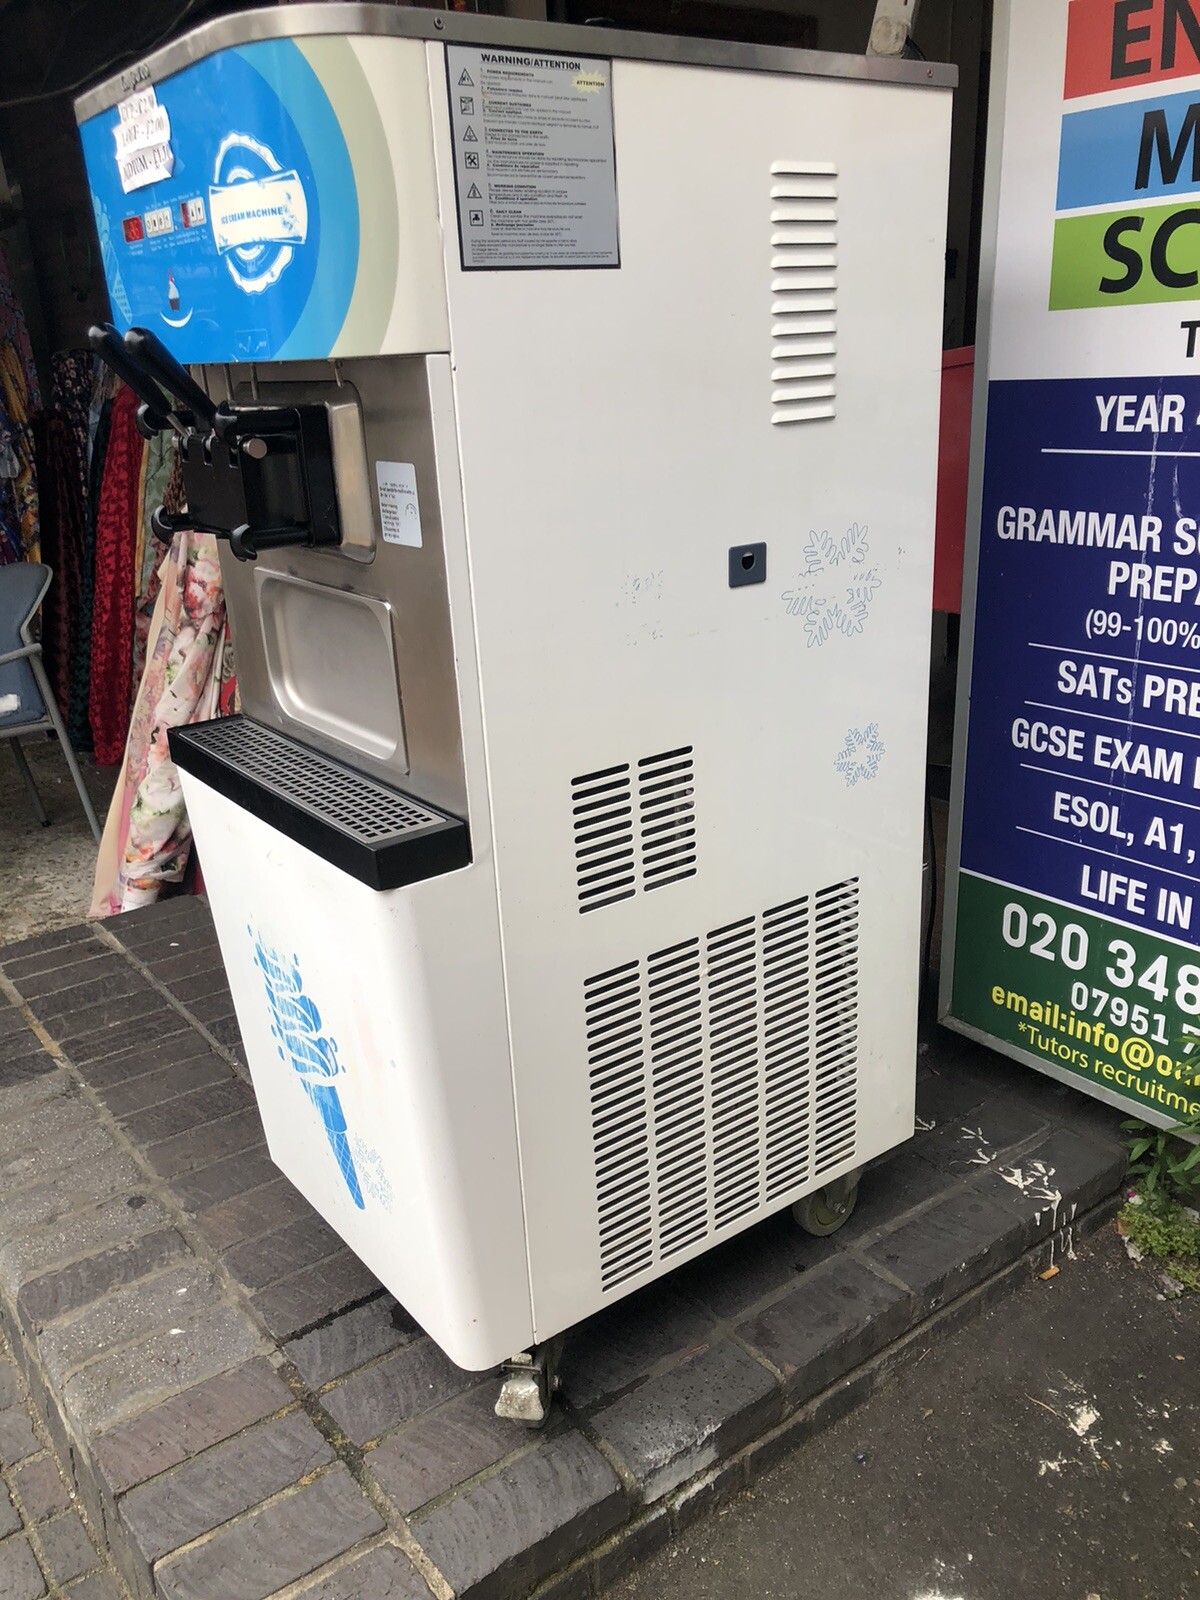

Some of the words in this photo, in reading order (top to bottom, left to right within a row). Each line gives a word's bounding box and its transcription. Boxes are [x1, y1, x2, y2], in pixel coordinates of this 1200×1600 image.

[481, 53, 581, 71] WARNING/ATTENTION
[246, 206, 283, 219] MACHINE
[1099, 208, 1200, 293] SC
[1095, 395, 1185, 433] YEAR
[997, 505, 1162, 552] GRAMMAR
[1173, 517, 1200, 556] S
[1108, 561, 1200, 606] PREP
[1086, 609, 1200, 650] (99-100%
[1058, 660, 1132, 704] SATs
[1012, 718, 1085, 762] GCSE
[1094, 734, 1183, 785] EXAM
[1053, 791, 1134, 847] ESOL,
[1144, 816, 1196, 864] A1,
[1081, 865, 1148, 915] LIFE
[1157, 888, 1193, 930] IN
[1002, 902, 1089, 971] 020
[1106, 939, 1200, 1015] 348
[991, 985, 1200, 1087] email:info@o
[1071, 981, 1174, 1045] 07951
